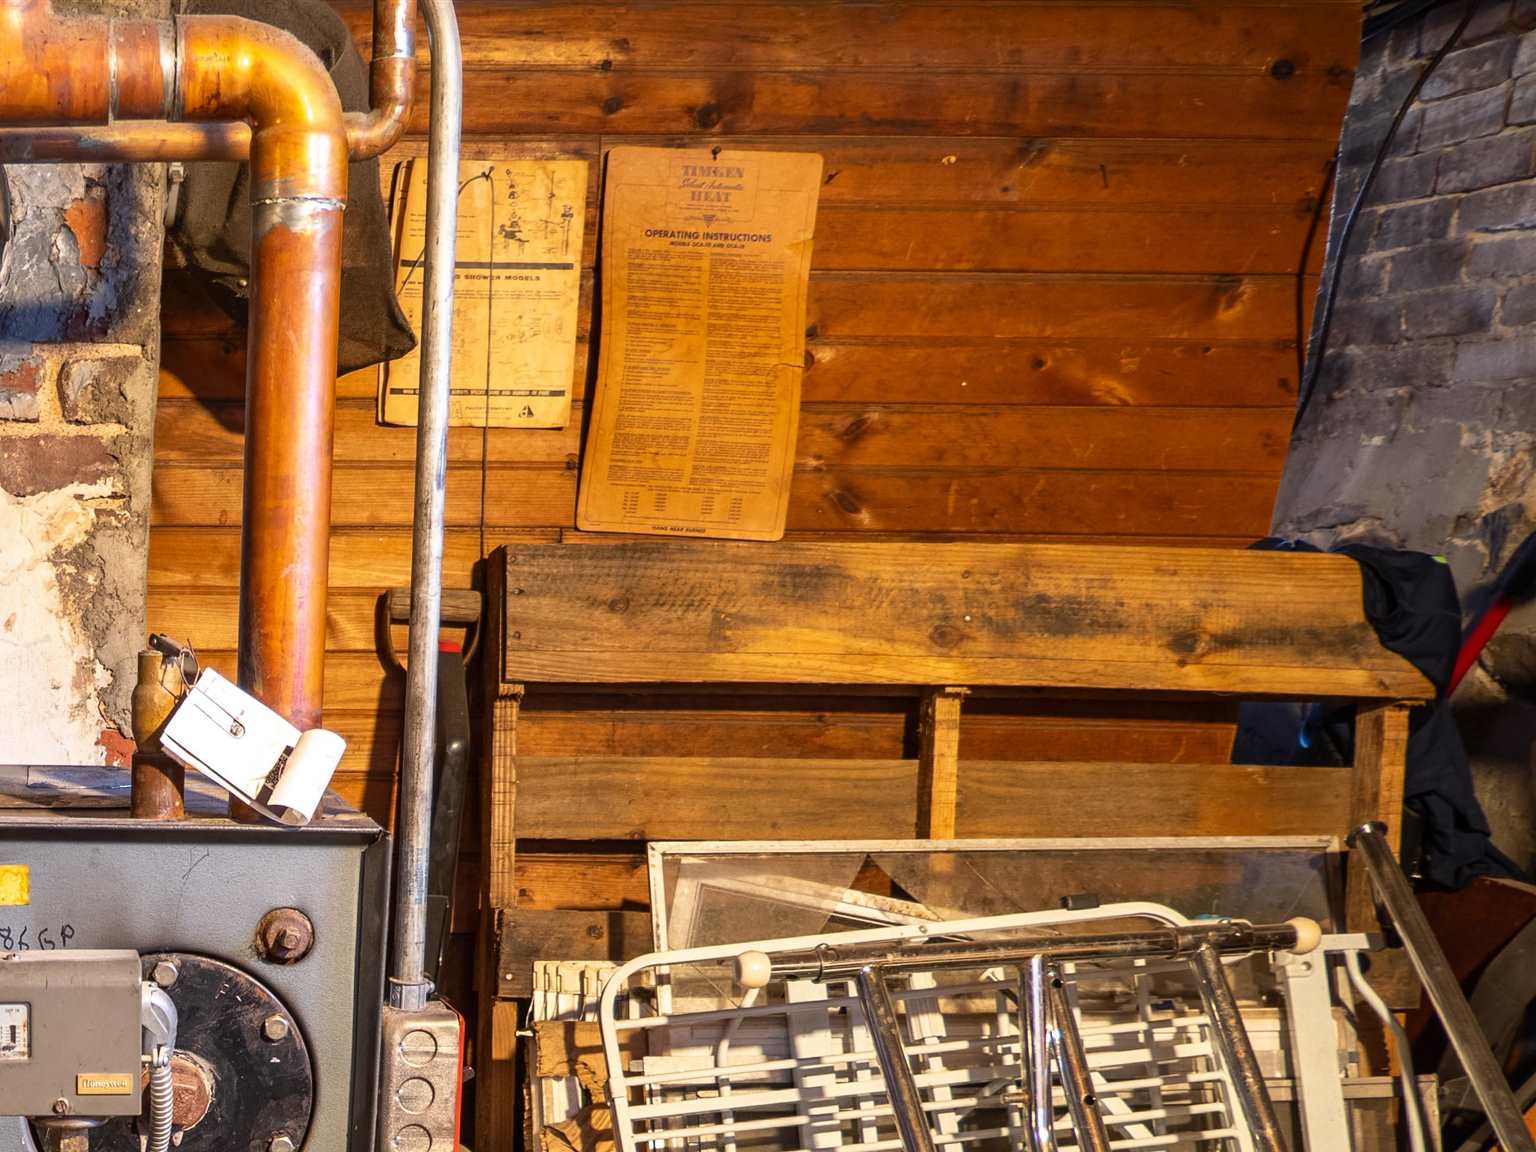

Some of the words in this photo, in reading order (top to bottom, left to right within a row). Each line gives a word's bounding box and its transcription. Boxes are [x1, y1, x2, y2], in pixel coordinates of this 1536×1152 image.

[690, 191, 732, 202] HEAT
[645, 229, 700, 240] OPERATING
[702, 231, 772, 242] INSTRUCTIONS
